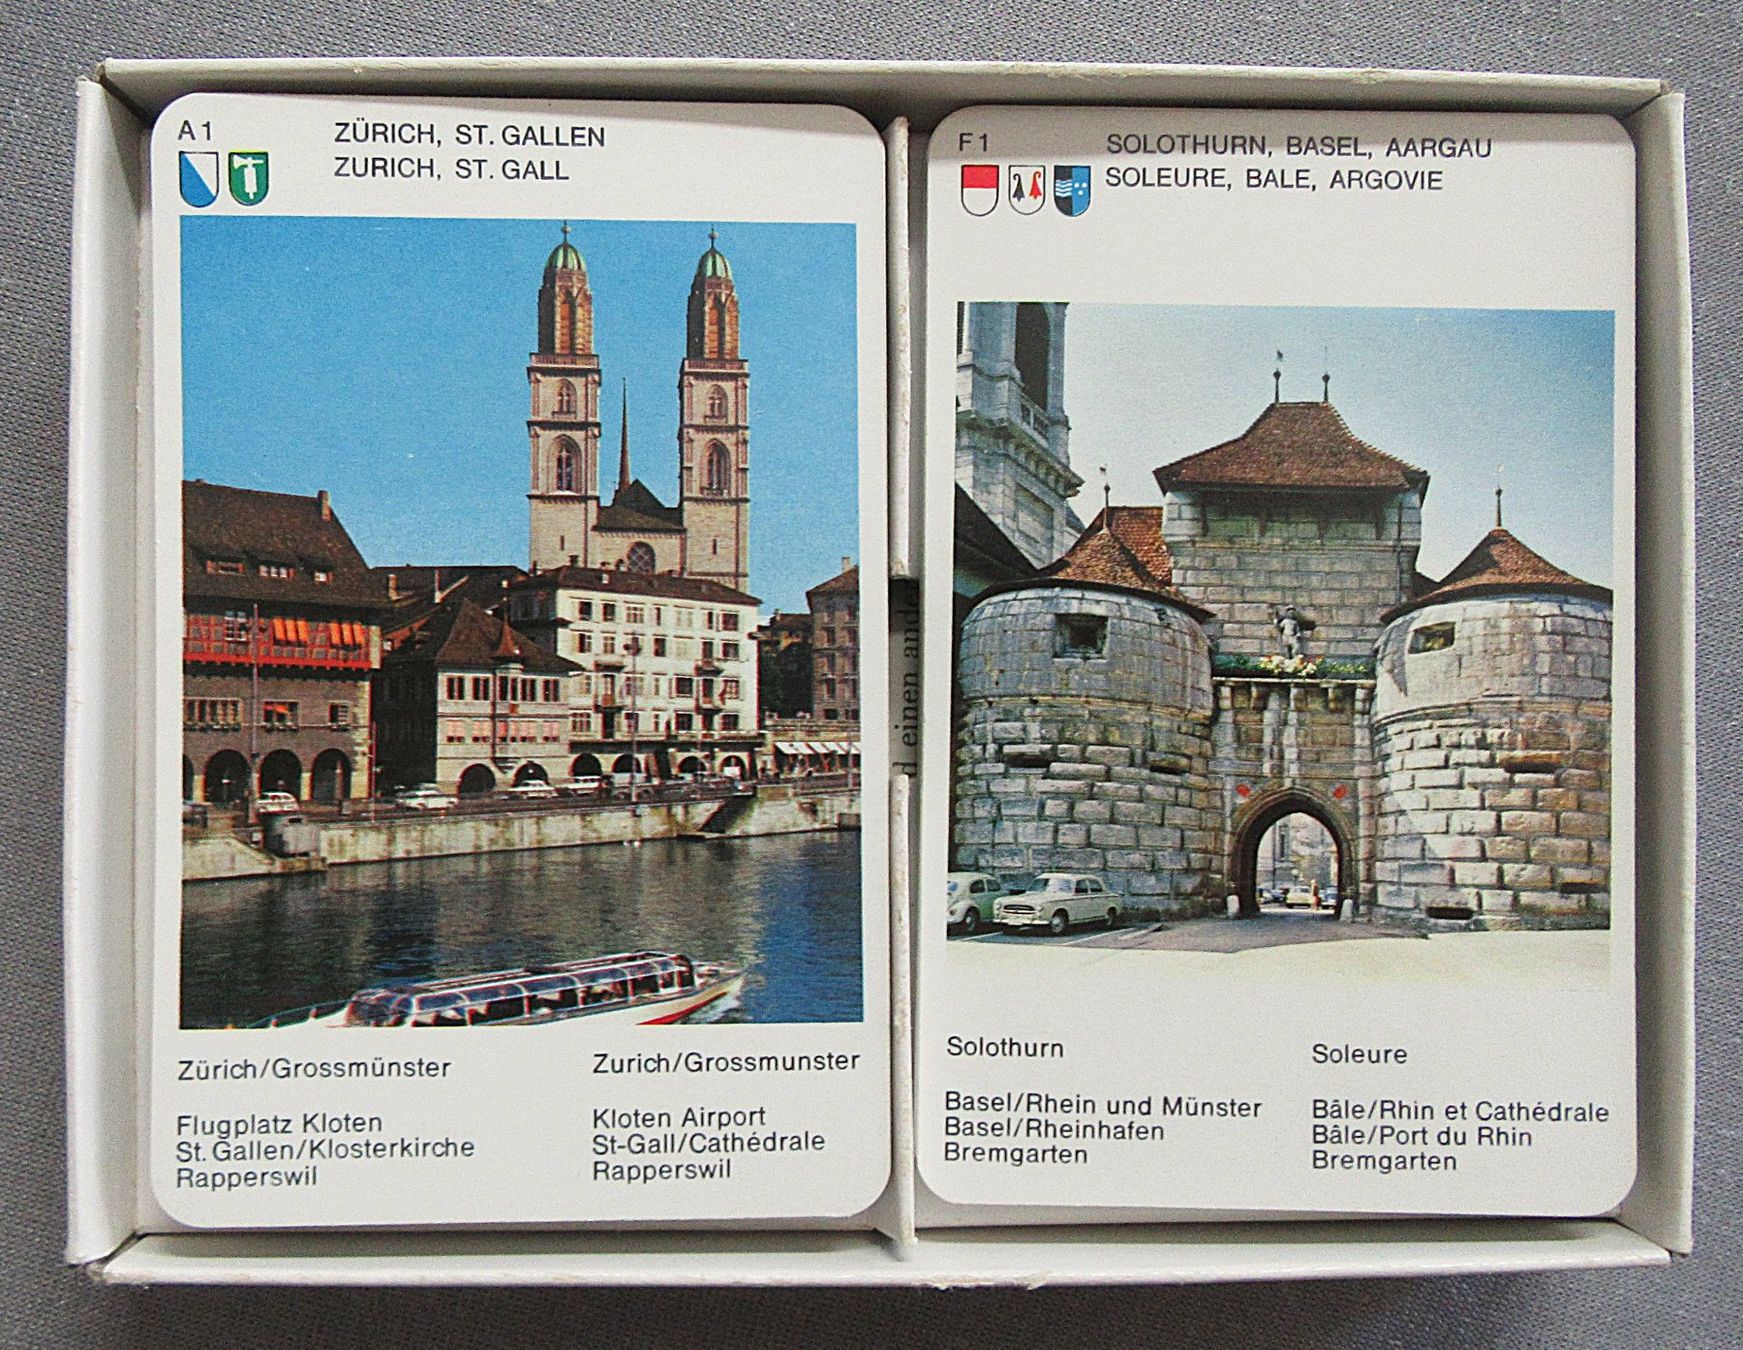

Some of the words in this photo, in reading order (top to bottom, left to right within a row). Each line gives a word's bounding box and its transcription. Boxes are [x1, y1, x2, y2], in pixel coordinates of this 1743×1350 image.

[177, 120, 196, 141] A
[201, 121, 211, 141] 1
[335, 117, 441, 148] ZÜRICH,
[455, 124, 494, 145] ST.
[502, 125, 605, 147] GALLEN
[959, 133, 973, 152] F
[979, 133, 988, 152] 1
[1106, 134, 1272, 158] SOLOTHURN,
[1286, 136, 1373, 160] BASEL,
[1385, 137, 1492, 158] AARGAU
[334, 157, 441, 181] ZURICH,
[455, 158, 494, 179] ST.
[502, 159, 570, 180] GALL
[1105, 167, 1231, 192] SOLEURE,
[1246, 168, 1316, 192] BALE,
[1329, 169, 1443, 190] ARGOVIE
[894, 672, 918, 747] einen
[947, 1036, 1064, 1058] Solothurn
[1312, 1043, 1407, 1064] Soleure
[178, 1057, 452, 1081] Zürich/Grossmünster
[593, 1052, 861, 1074] Zurich/Grossmunster
[945, 1091, 1096, 1114] Basel/Rhein
[1107, 1096, 1152, 1116] und
[1162, 1096, 1263, 1118] Münster
[1312, 1099, 1434, 1121] Bâle/Rhin
[1445, 1101, 1468, 1121] et
[1475, 1101, 1609, 1123] Cathédrale
[177, 1114, 293, 1140] Flugplatz
[302, 1112, 382, 1133] Kloten
[593, 1108, 671, 1129] Kloten
[681, 1106, 766, 1131] Airport
[945, 1116, 1164, 1141] Basel/Rheinhafen
[592, 1130, 825, 1155] St-Gall/Cathédrale
[1312, 1124, 1428, 1146] Bâle/Port
[1436, 1126, 1467, 1146] du
[1478, 1126, 1532, 1147] Rhin
[176, 1141, 207, 1163] St.
[213, 1137, 475, 1162] Gallen/Klosterkirche
[944, 1141, 1087, 1167] Bremgarten
[1312, 1149, 1457, 1175] Bremgarten
[177, 1165, 317, 1192] Rapperswil
[593, 1158, 731, 1184] Rapperswil
